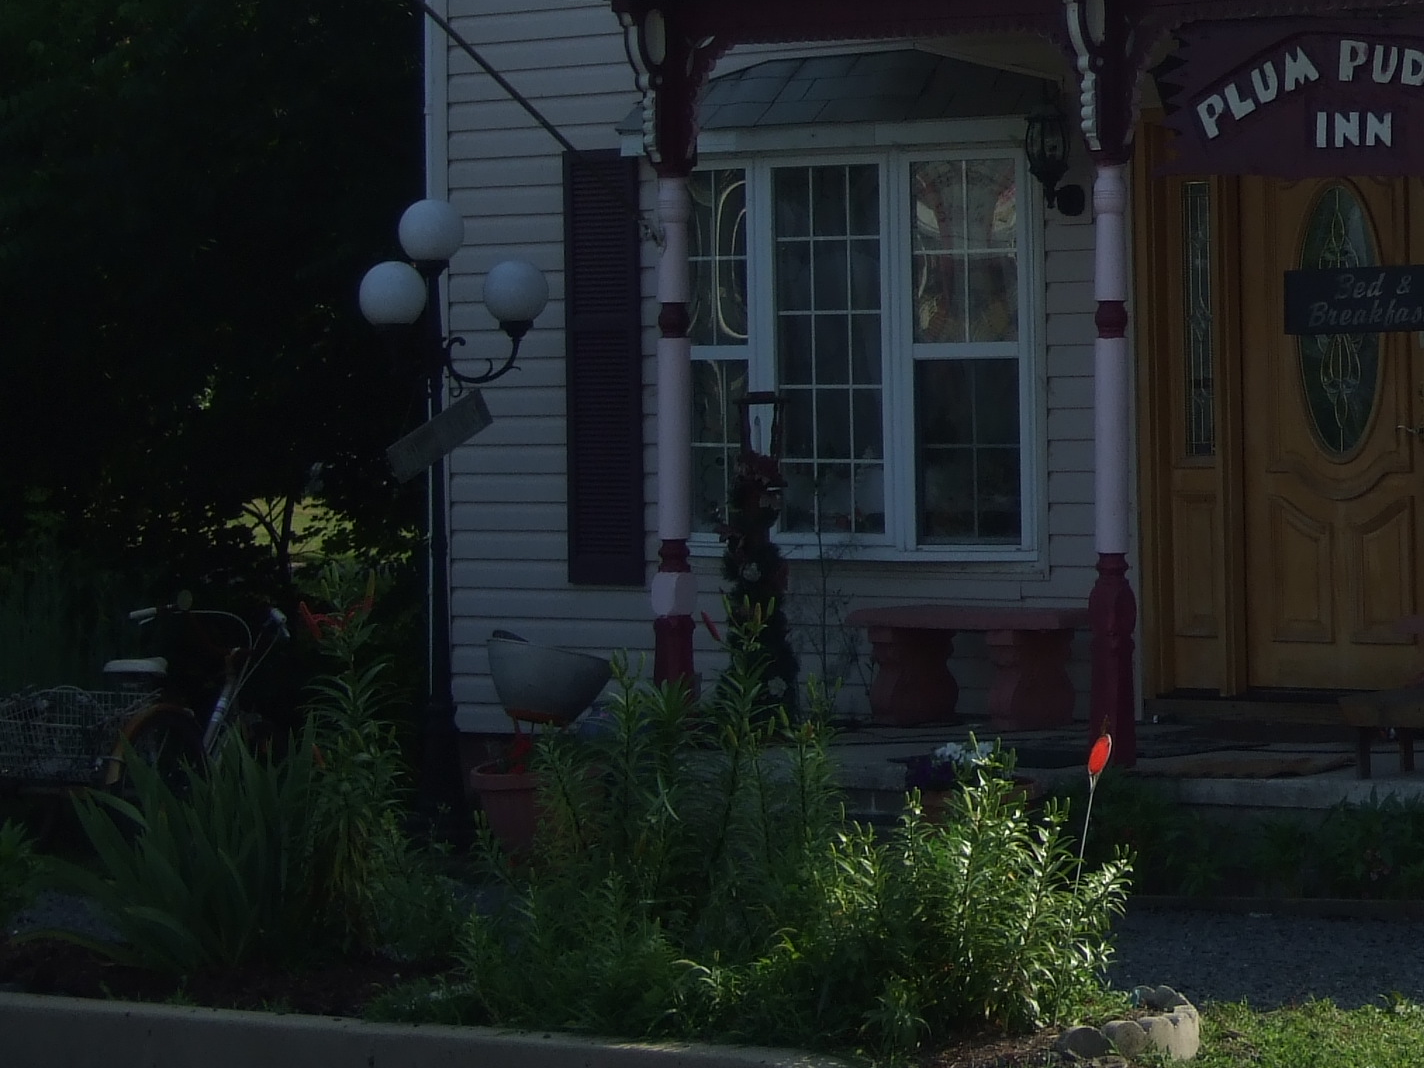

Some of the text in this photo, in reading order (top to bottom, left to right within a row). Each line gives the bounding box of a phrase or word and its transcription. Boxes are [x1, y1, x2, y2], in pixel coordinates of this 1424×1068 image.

[1196, 46, 1320, 140] PLUM
[1315, 111, 1392, 148] INN
[1334, 271, 1412, 300] Bed &
